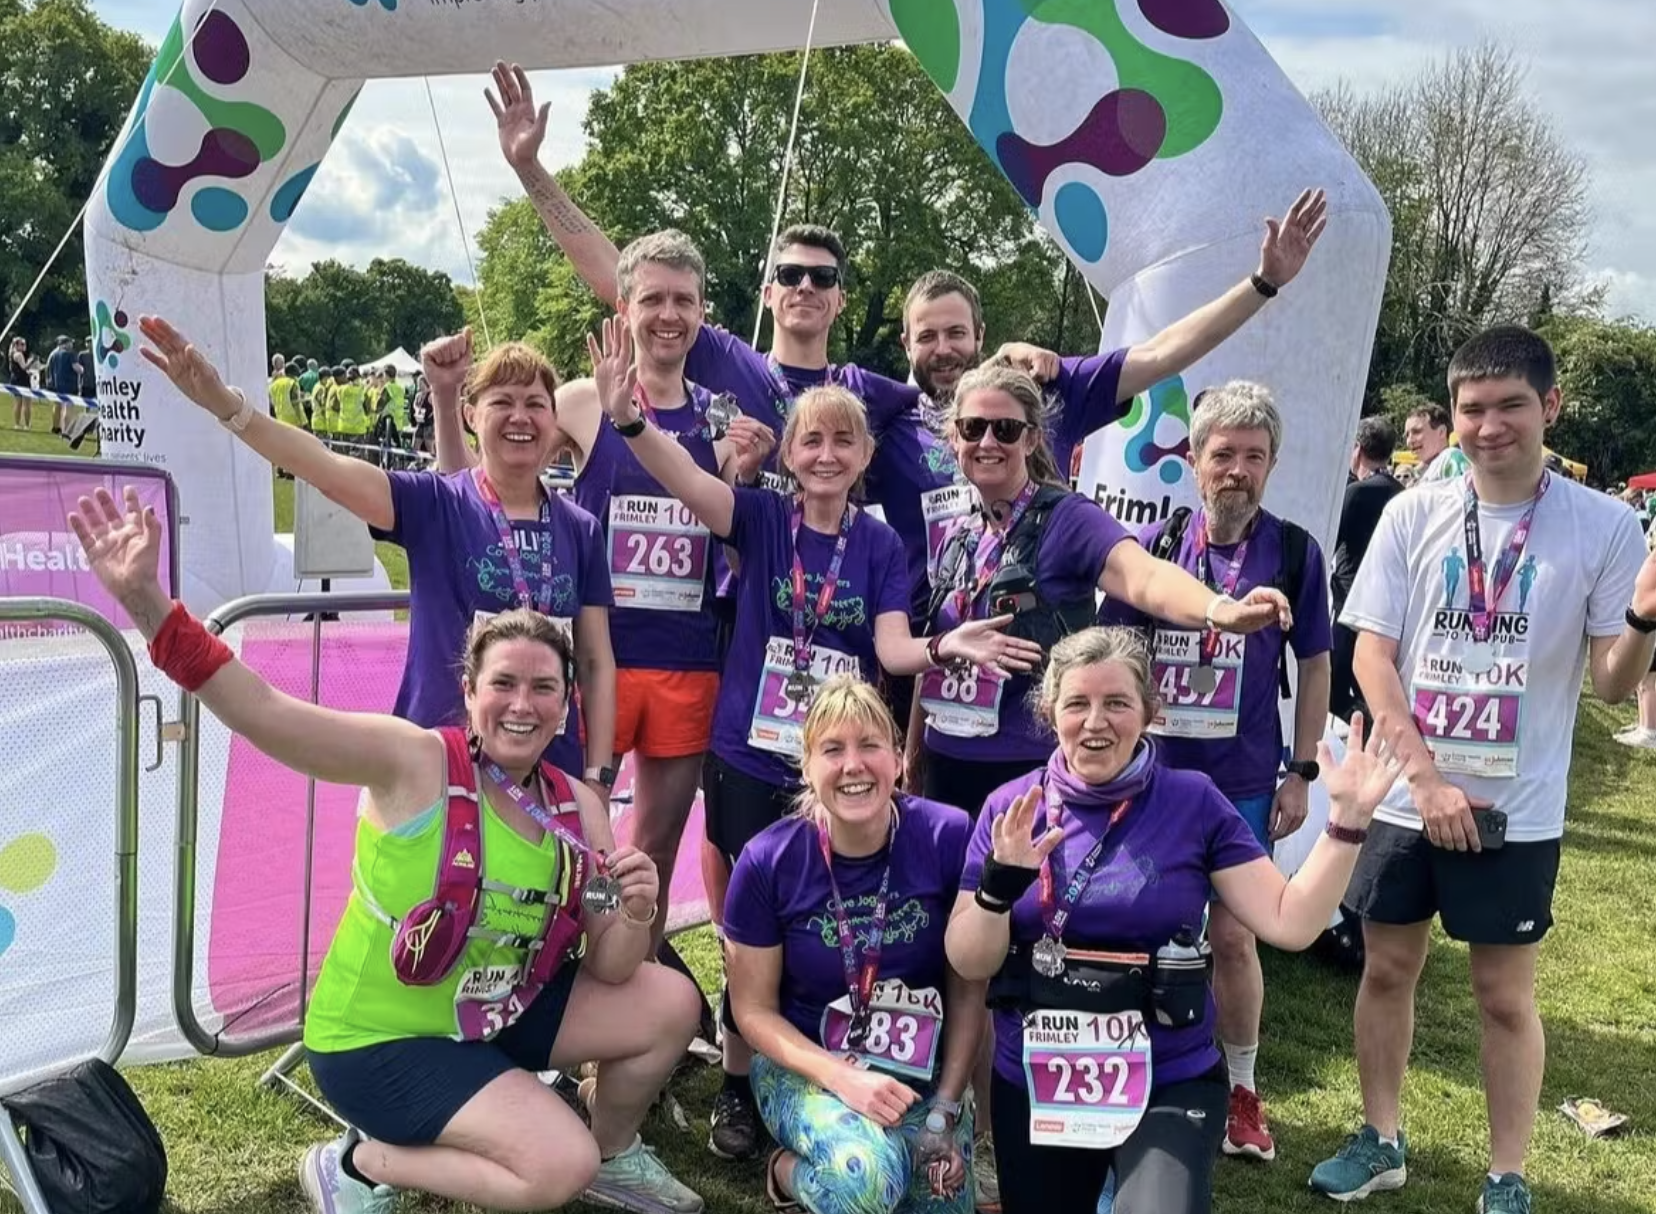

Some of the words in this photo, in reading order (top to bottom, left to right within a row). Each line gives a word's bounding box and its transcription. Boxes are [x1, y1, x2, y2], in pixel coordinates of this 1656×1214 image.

[935, 489, 959, 504] RUN
[1095, 482, 1171, 525] Friml
[627, 501, 658, 514] RUN
[664, 503, 699, 527] 10
[614, 512, 657, 524] FRIMLEY
[0, 542, 90, 572] Healt
[626, 533, 693, 576] 263
[1434, 611, 1528, 635] RUNING
[1164, 634, 1190, 646] RUN
[1492, 635, 1516, 645] PUB
[1430, 659, 1462, 674] RUN
[1419, 671, 1462, 685] FRIMLEY
[1426, 694, 1501, 740] 424
[586, 892, 606, 900] RUN
[1065, 869, 1090, 904] 2024
[1042, 1016, 1079, 1030] RUN
[1087, 1015, 1150, 1042] 10K
[840, 1011, 918, 1061] 83
[1029, 1032, 1079, 1043] FRIMLEY
[1047, 1056, 1129, 1103] 232
